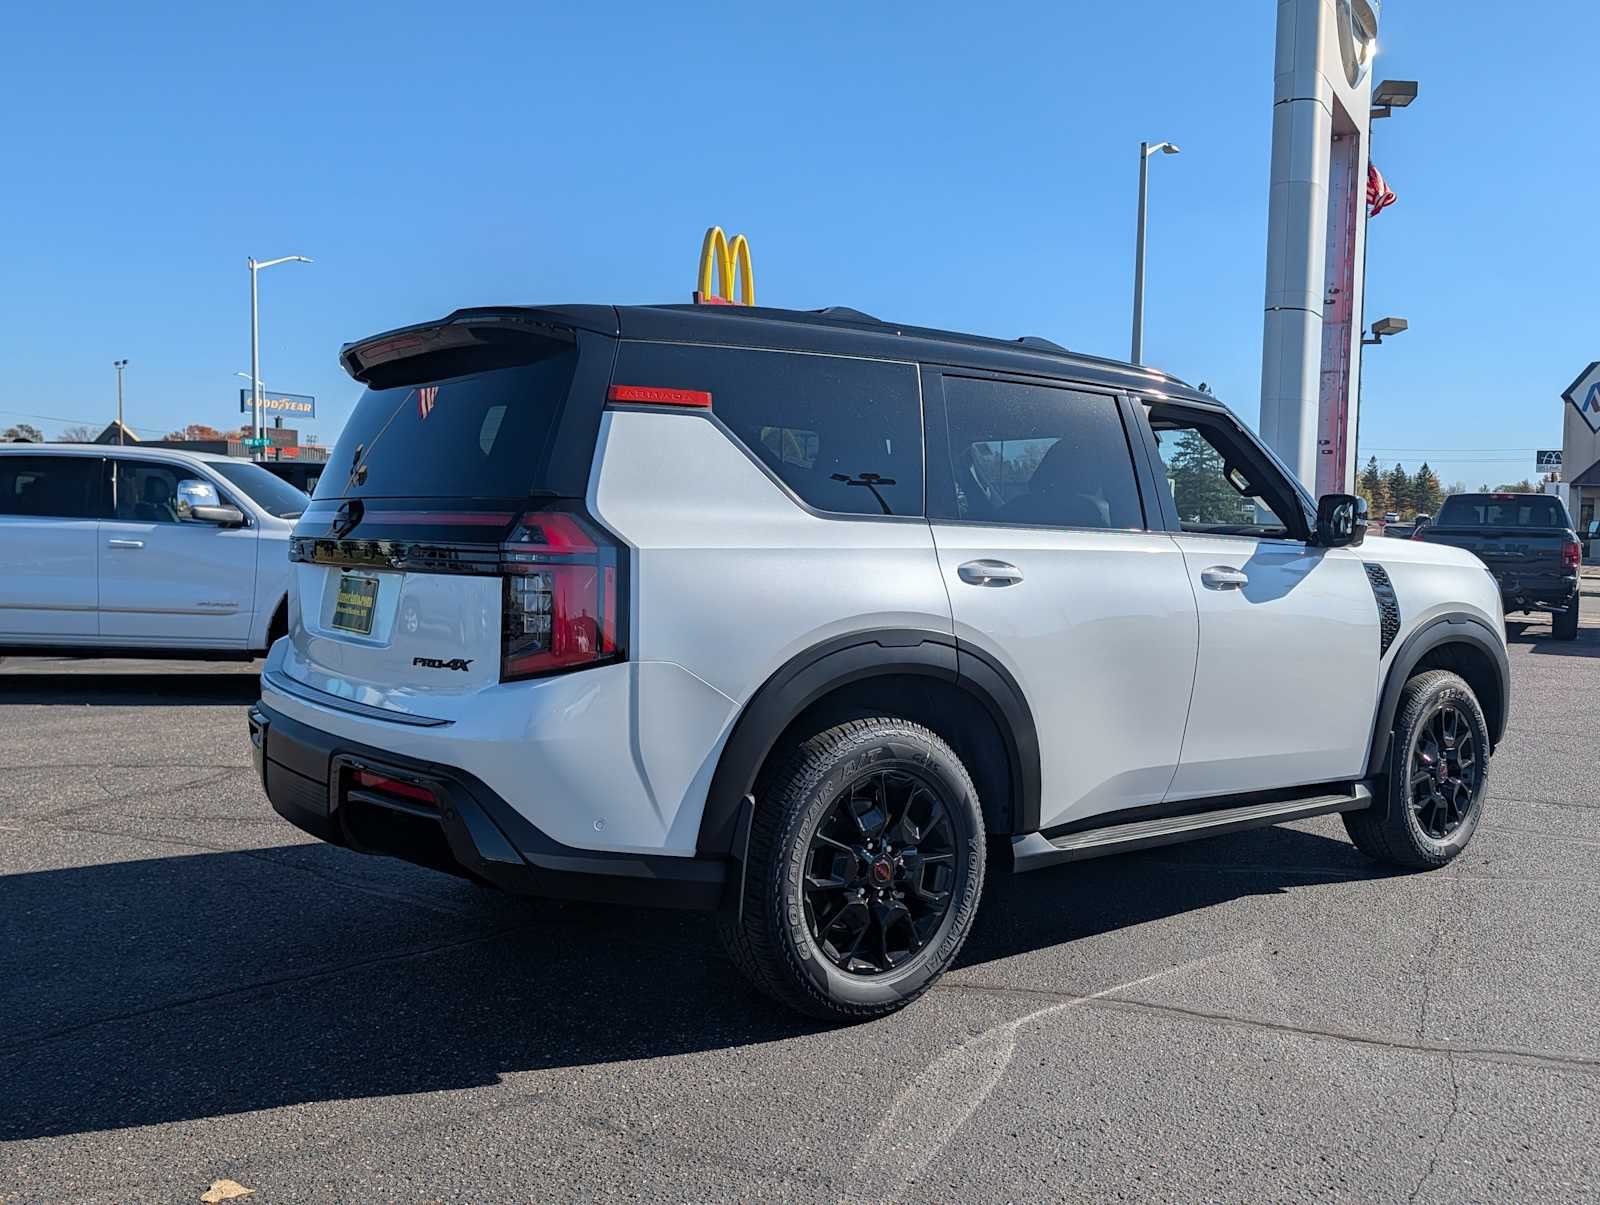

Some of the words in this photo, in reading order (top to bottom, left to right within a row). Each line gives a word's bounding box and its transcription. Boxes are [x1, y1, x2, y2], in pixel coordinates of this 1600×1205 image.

[413, 657, 474, 672] PRO-4X
[787, 780, 834, 960] GEOLANDAR
[927, 837, 977, 974] YOKOHAMA
